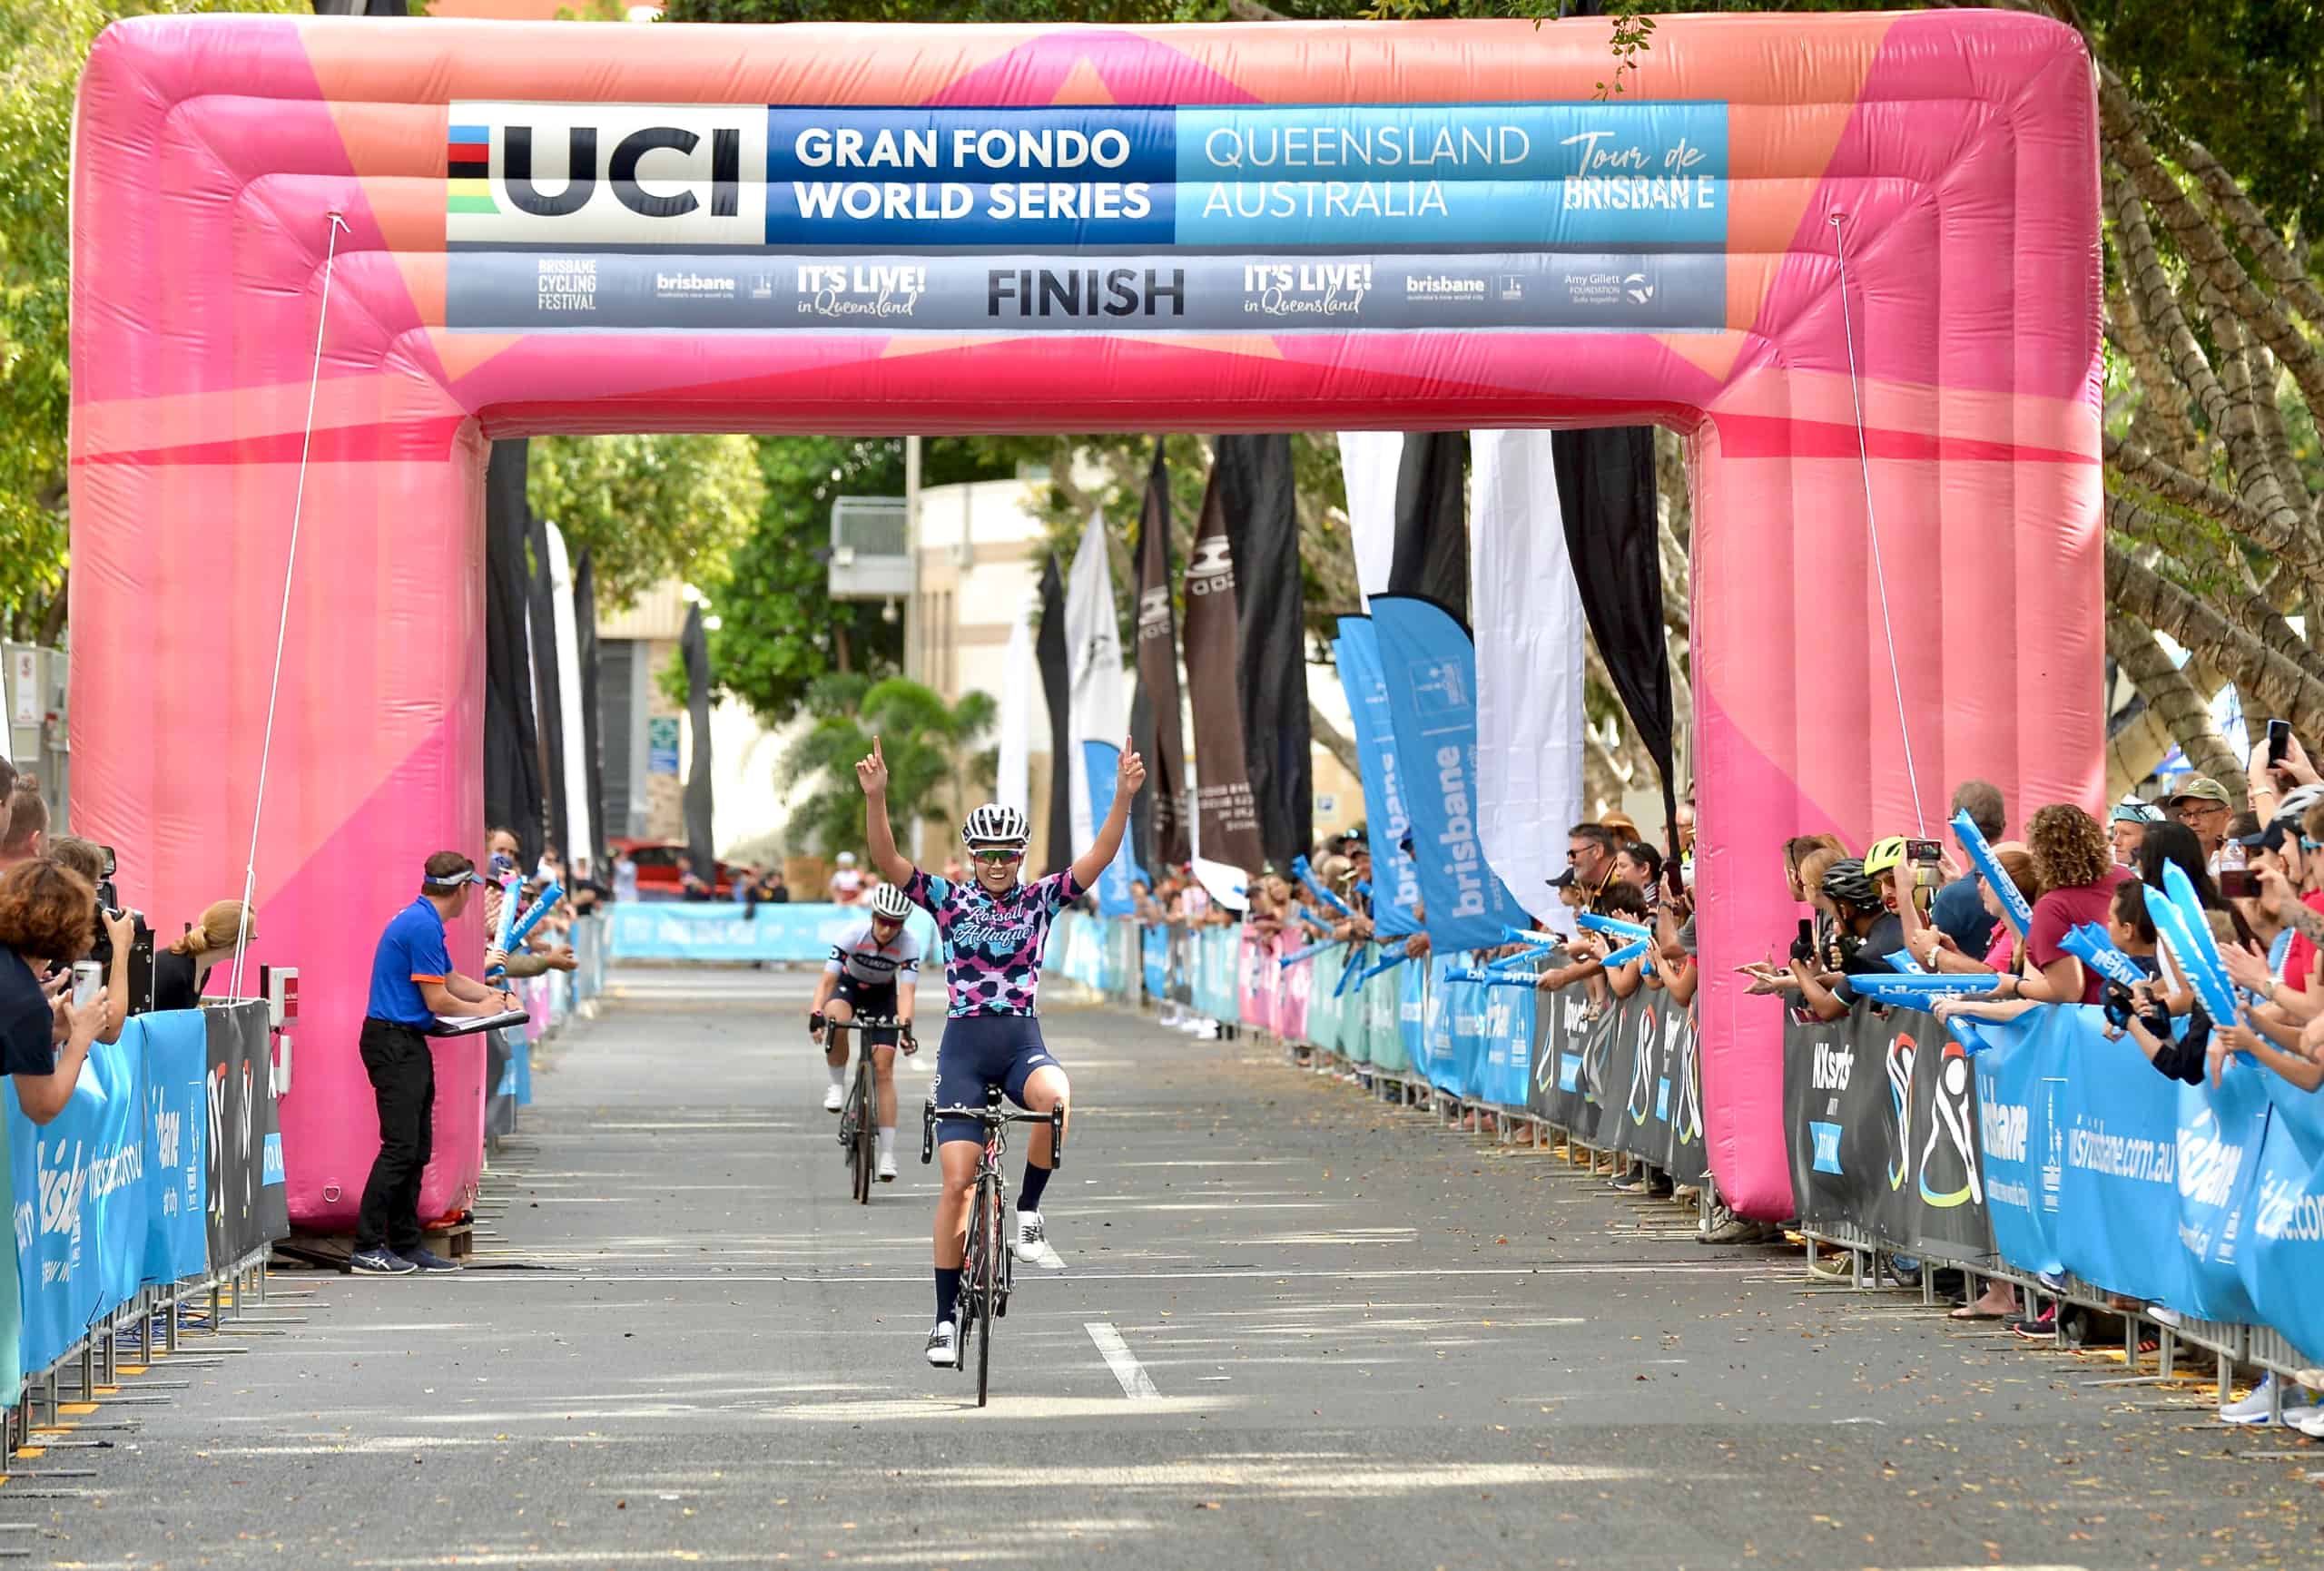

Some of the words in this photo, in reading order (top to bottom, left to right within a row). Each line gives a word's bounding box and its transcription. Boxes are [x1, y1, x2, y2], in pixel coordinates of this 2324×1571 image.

[795, 129, 941, 168] GRAN
[954, 129, 1130, 168] FONDO
[1204, 125, 1531, 168] QUEENSLAND
[1560, 131, 1650, 179] Tour
[1664, 137, 1707, 174] de
[503, 126, 740, 218] UCI
[793, 182, 974, 220] WORLD
[987, 182, 1151, 220] SERIES
[1202, 181, 1449, 219] AUSTRALIA
[1563, 174, 1715, 210] BRISBANE
[537, 259, 596, 273] BRISBANE
[656, 273, 734, 290] brisbane
[798, 265, 847, 293] IT'S
[853, 265, 926, 292] LIVE!
[1245, 264, 1294, 291] IT'S
[1300, 263, 1373, 291] LIVE!
[1564, 274, 1588, 285] Amy
[1590, 273, 1620, 284] Gillett
[538, 273, 596, 292] CYCLING
[988, 269, 1185, 317] FINISH
[1406, 276, 1485, 292] brisbane
[537, 293, 596, 310] FESTIVAL
[798, 300, 812, 313] in
[814, 288, 918, 318] Queensland
[1245, 299, 1258, 312] in
[1262, 284, 1364, 316] Queensland
[1436, 745, 1485, 918] brisbane
